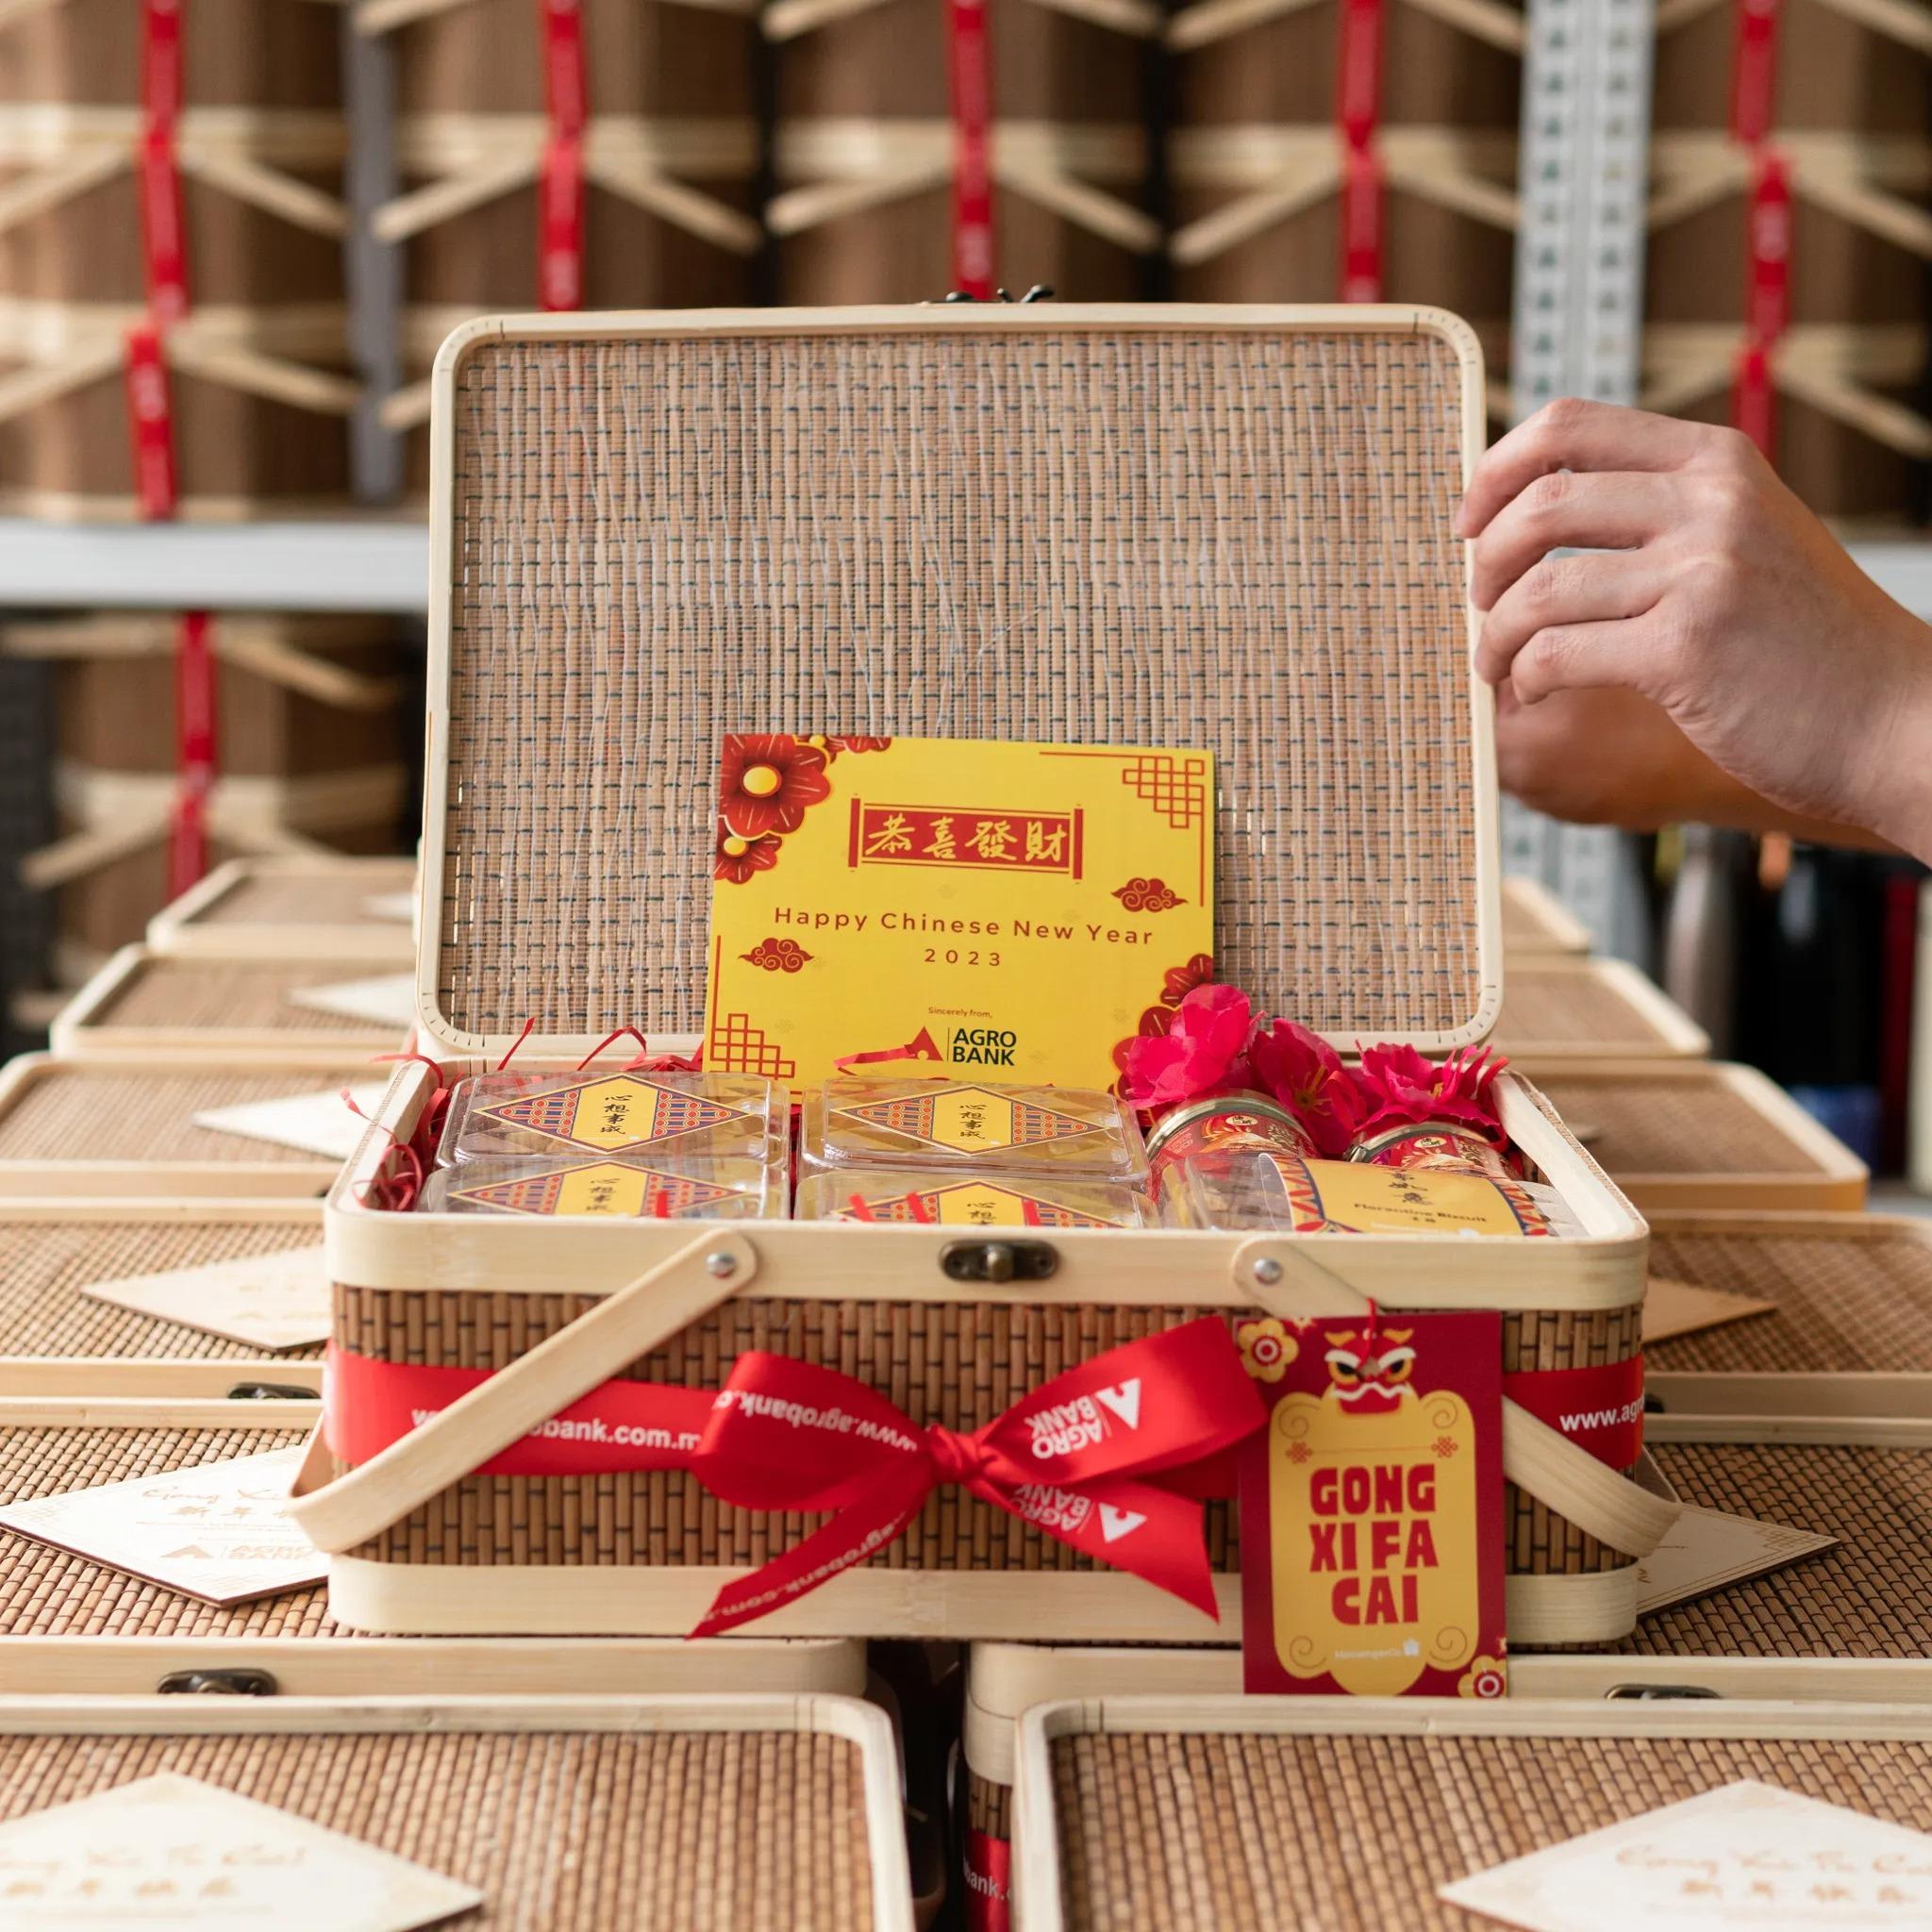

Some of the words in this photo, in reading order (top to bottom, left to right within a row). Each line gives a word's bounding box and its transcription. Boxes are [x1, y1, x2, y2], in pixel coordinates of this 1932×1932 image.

[864, 812, 1068, 862] 恭喜發財
[774, 907, 868, 931] Happy
[881, 912, 1000, 936] Chinese
[1013, 920, 1074, 941] New
[1086, 924, 1153, 944] Year
[924, 948, 1001, 967] 2023
[928, 1007, 967, 1018] Sincerely
[952, 1046, 1015, 1066] BANK
[953, 1028, 1017, 1048] AGRO
[1024, 1395, 1098, 1440] BANK
[1032, 1418, 1102, 1459] AGRO
[1309, 1463, 1436, 1517] GONG
[1308, 1522, 1357, 1573] XI
[1371, 1519, 1439, 1571] FA
[1331, 1574, 1419, 1625] CAI
